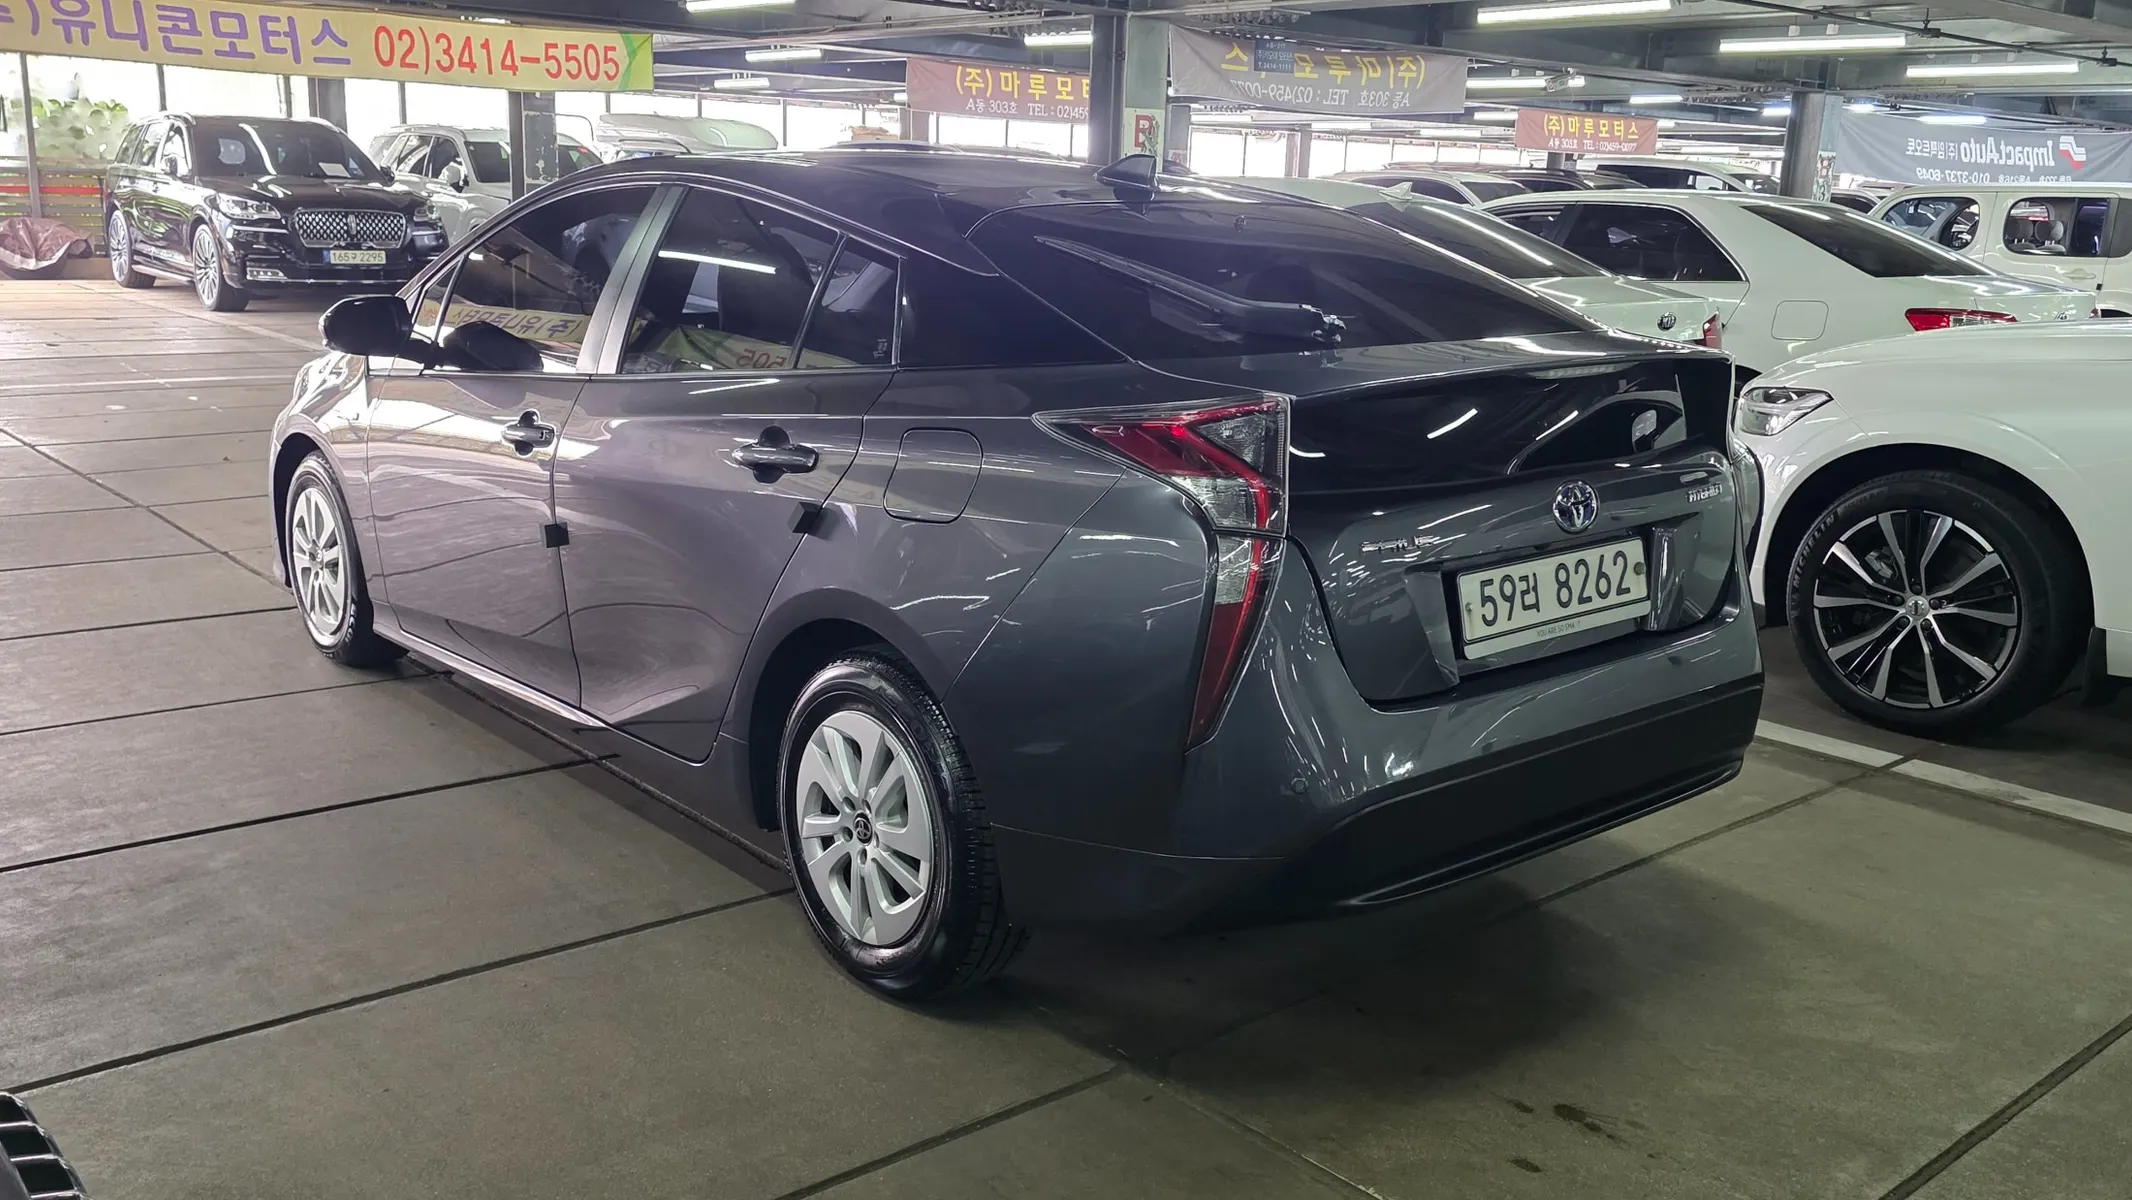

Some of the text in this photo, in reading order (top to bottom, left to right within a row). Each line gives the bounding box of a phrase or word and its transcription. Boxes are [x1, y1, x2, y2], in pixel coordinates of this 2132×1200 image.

[374, 25, 620, 81] 02)3414-5505
[988, 101, 1019, 115] 303호
[360, 252, 384, 261] 2295
[1554, 550, 1631, 609] 8262
